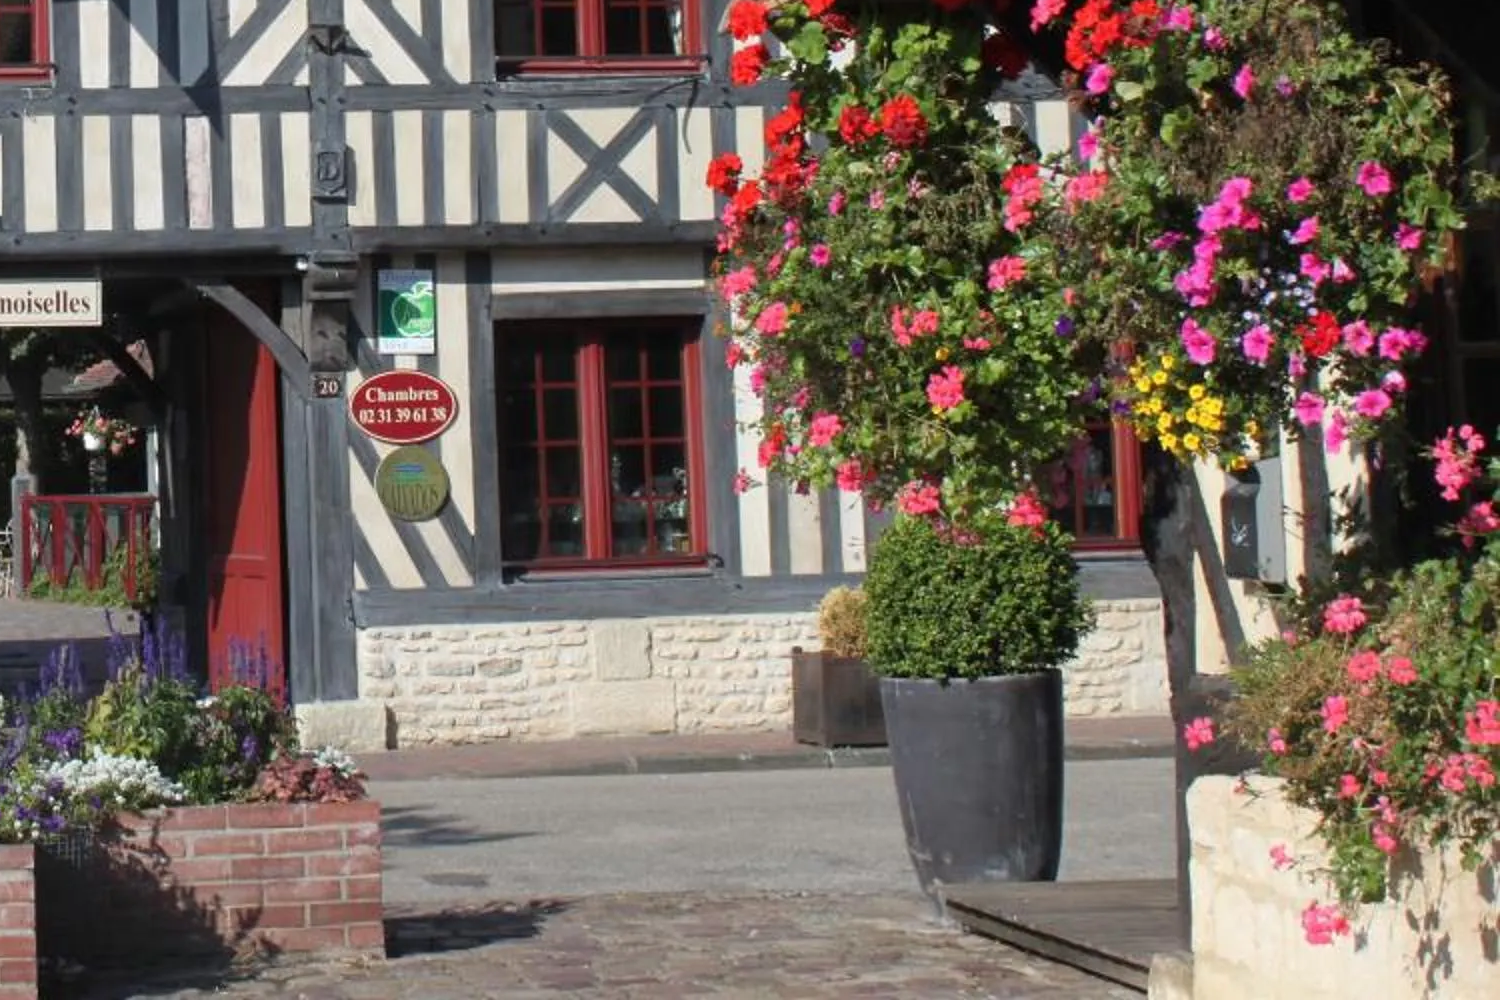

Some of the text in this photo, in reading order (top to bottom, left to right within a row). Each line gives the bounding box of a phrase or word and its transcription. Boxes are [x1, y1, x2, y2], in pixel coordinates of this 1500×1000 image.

[319, 380, 338, 395] 20
[365, 387, 439, 403] Chambres
[359, 407, 446, 424] 02 31 39 61 38
